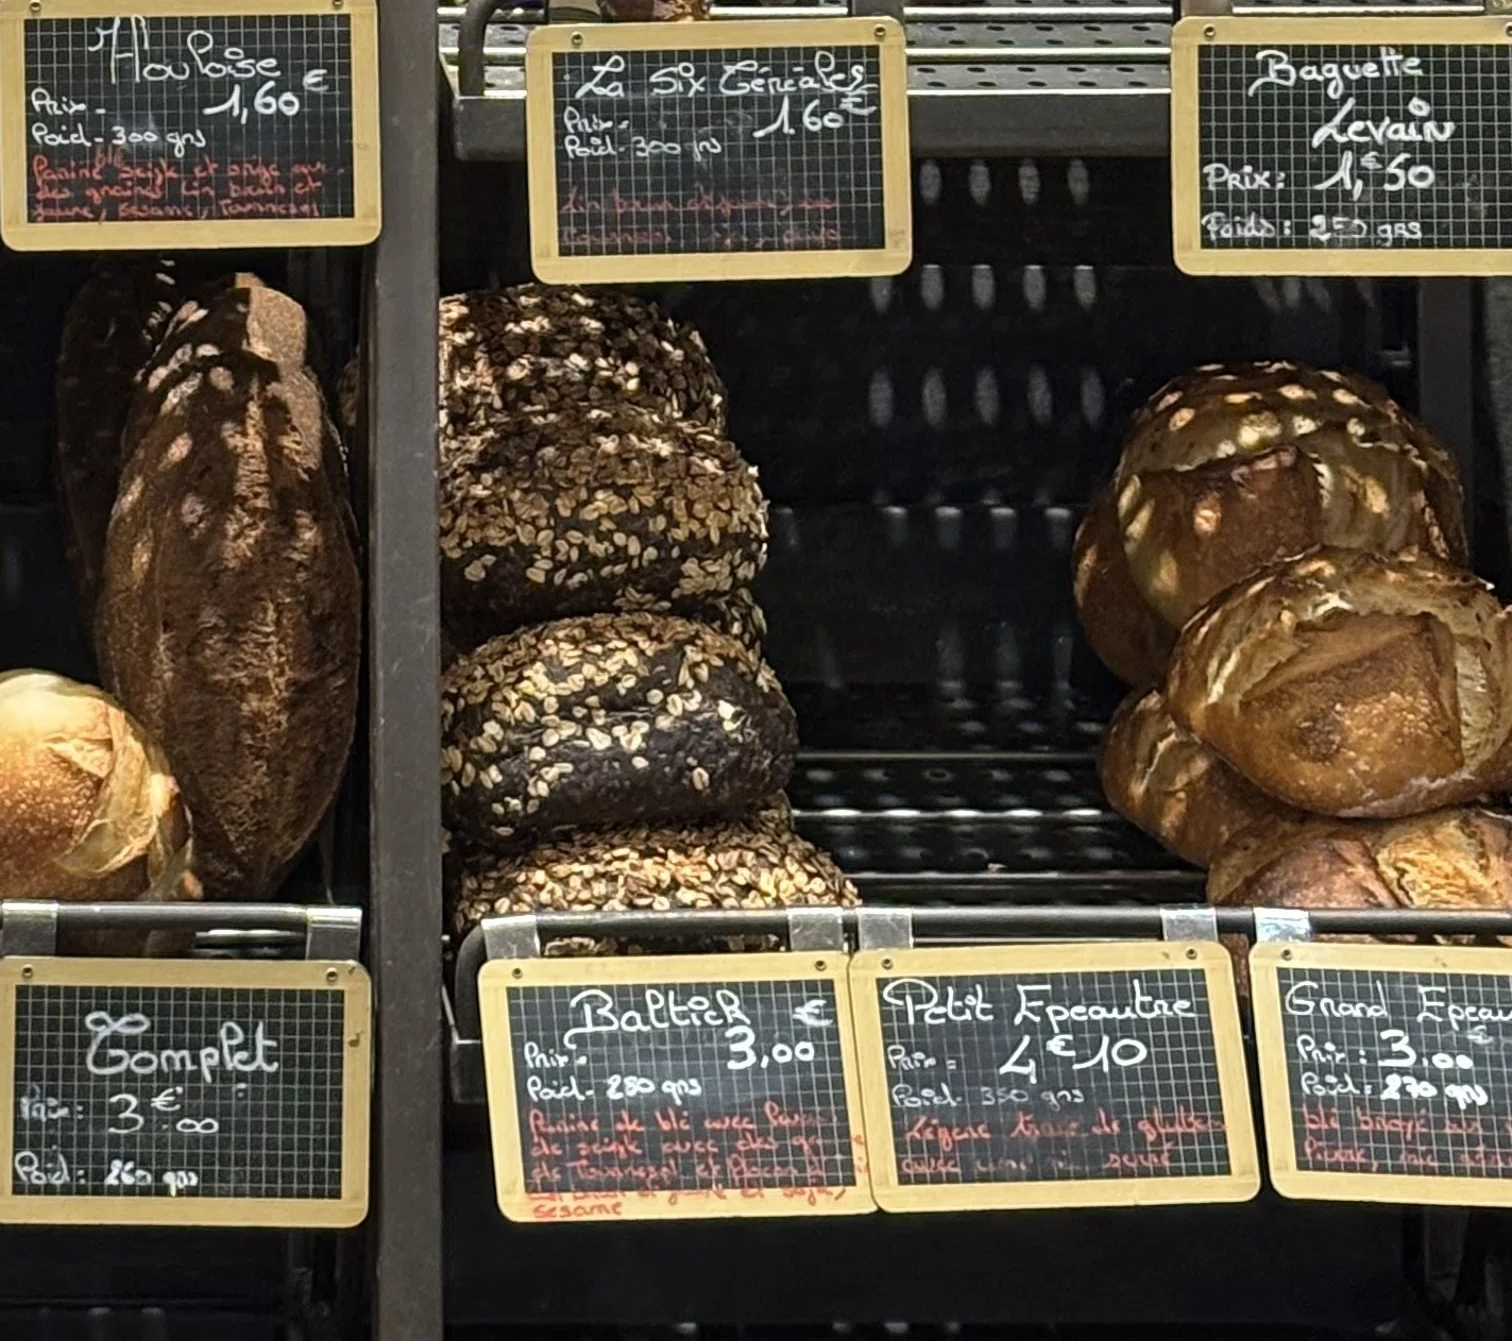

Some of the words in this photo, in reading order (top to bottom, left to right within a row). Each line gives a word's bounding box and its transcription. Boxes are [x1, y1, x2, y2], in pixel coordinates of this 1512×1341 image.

[649, 62, 706, 97] Six
[1248, 46, 1425, 100] Baguette
[111, 125, 158, 144] 300
[1312, 97, 1456, 149] Levain
[632, 136, 681, 157] 300
[882, 978, 994, 1025] Petit
[1014, 979, 1197, 1033] Epeautre
[1286, 980, 1389, 1018] Grand
[85, 1011, 279, 1084] Complet
[981, 1084, 1028, 1104] 350
